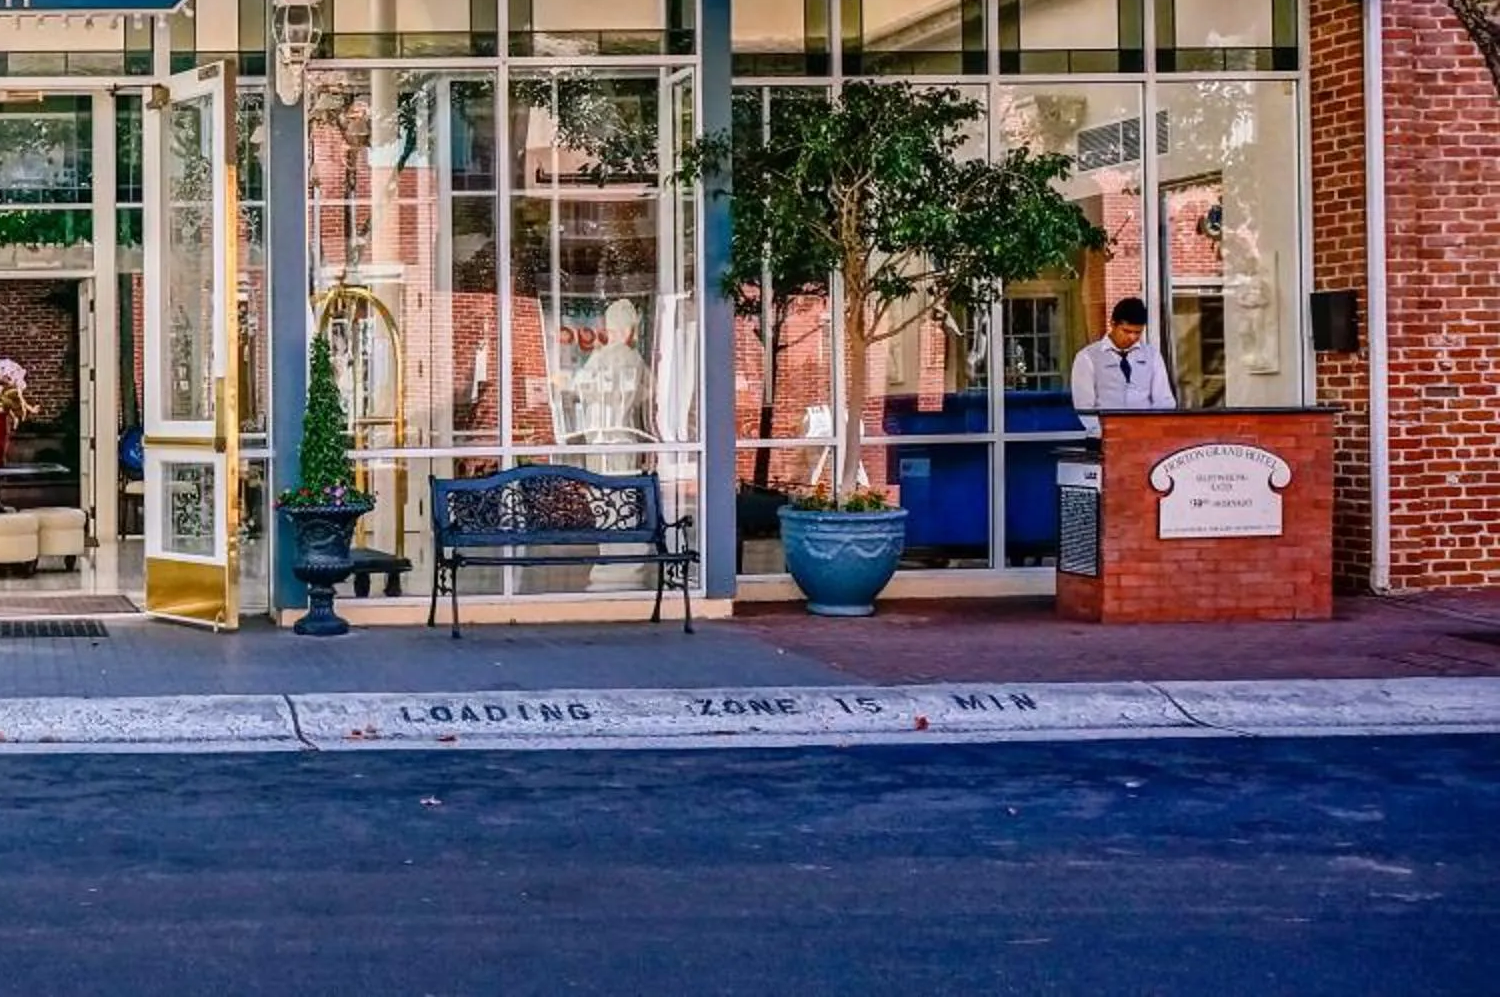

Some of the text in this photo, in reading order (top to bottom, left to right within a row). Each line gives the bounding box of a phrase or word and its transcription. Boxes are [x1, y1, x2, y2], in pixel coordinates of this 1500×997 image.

[399, 692, 1038, 722] LOADING ZONE 15 MIN
